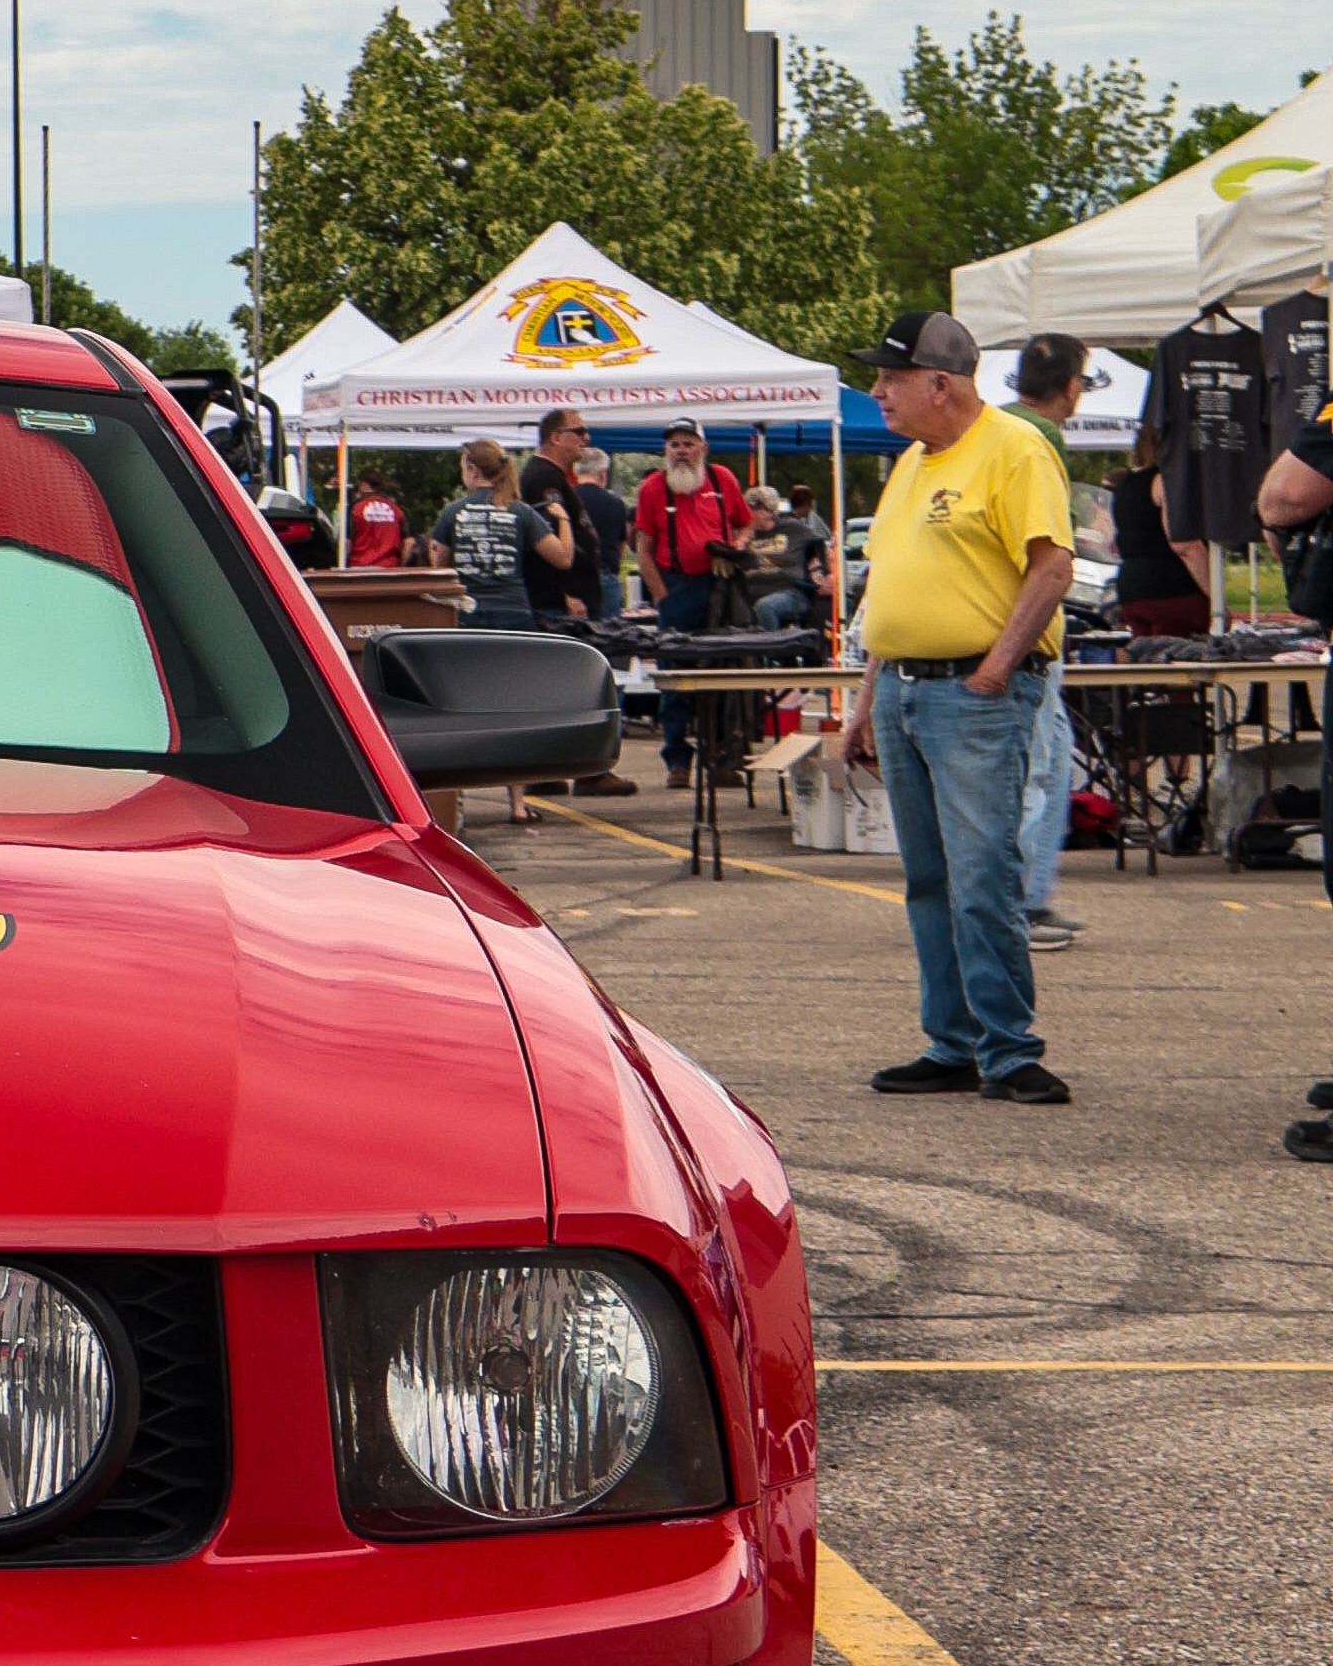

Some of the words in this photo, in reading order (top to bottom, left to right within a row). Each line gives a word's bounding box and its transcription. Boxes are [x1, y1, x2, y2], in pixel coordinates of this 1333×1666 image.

[357, 389, 475, 406] CHRISTIAN
[483, 386, 666, 406] MOTORCYCLISTS
[673, 385, 822, 403] ASSOCIATION
